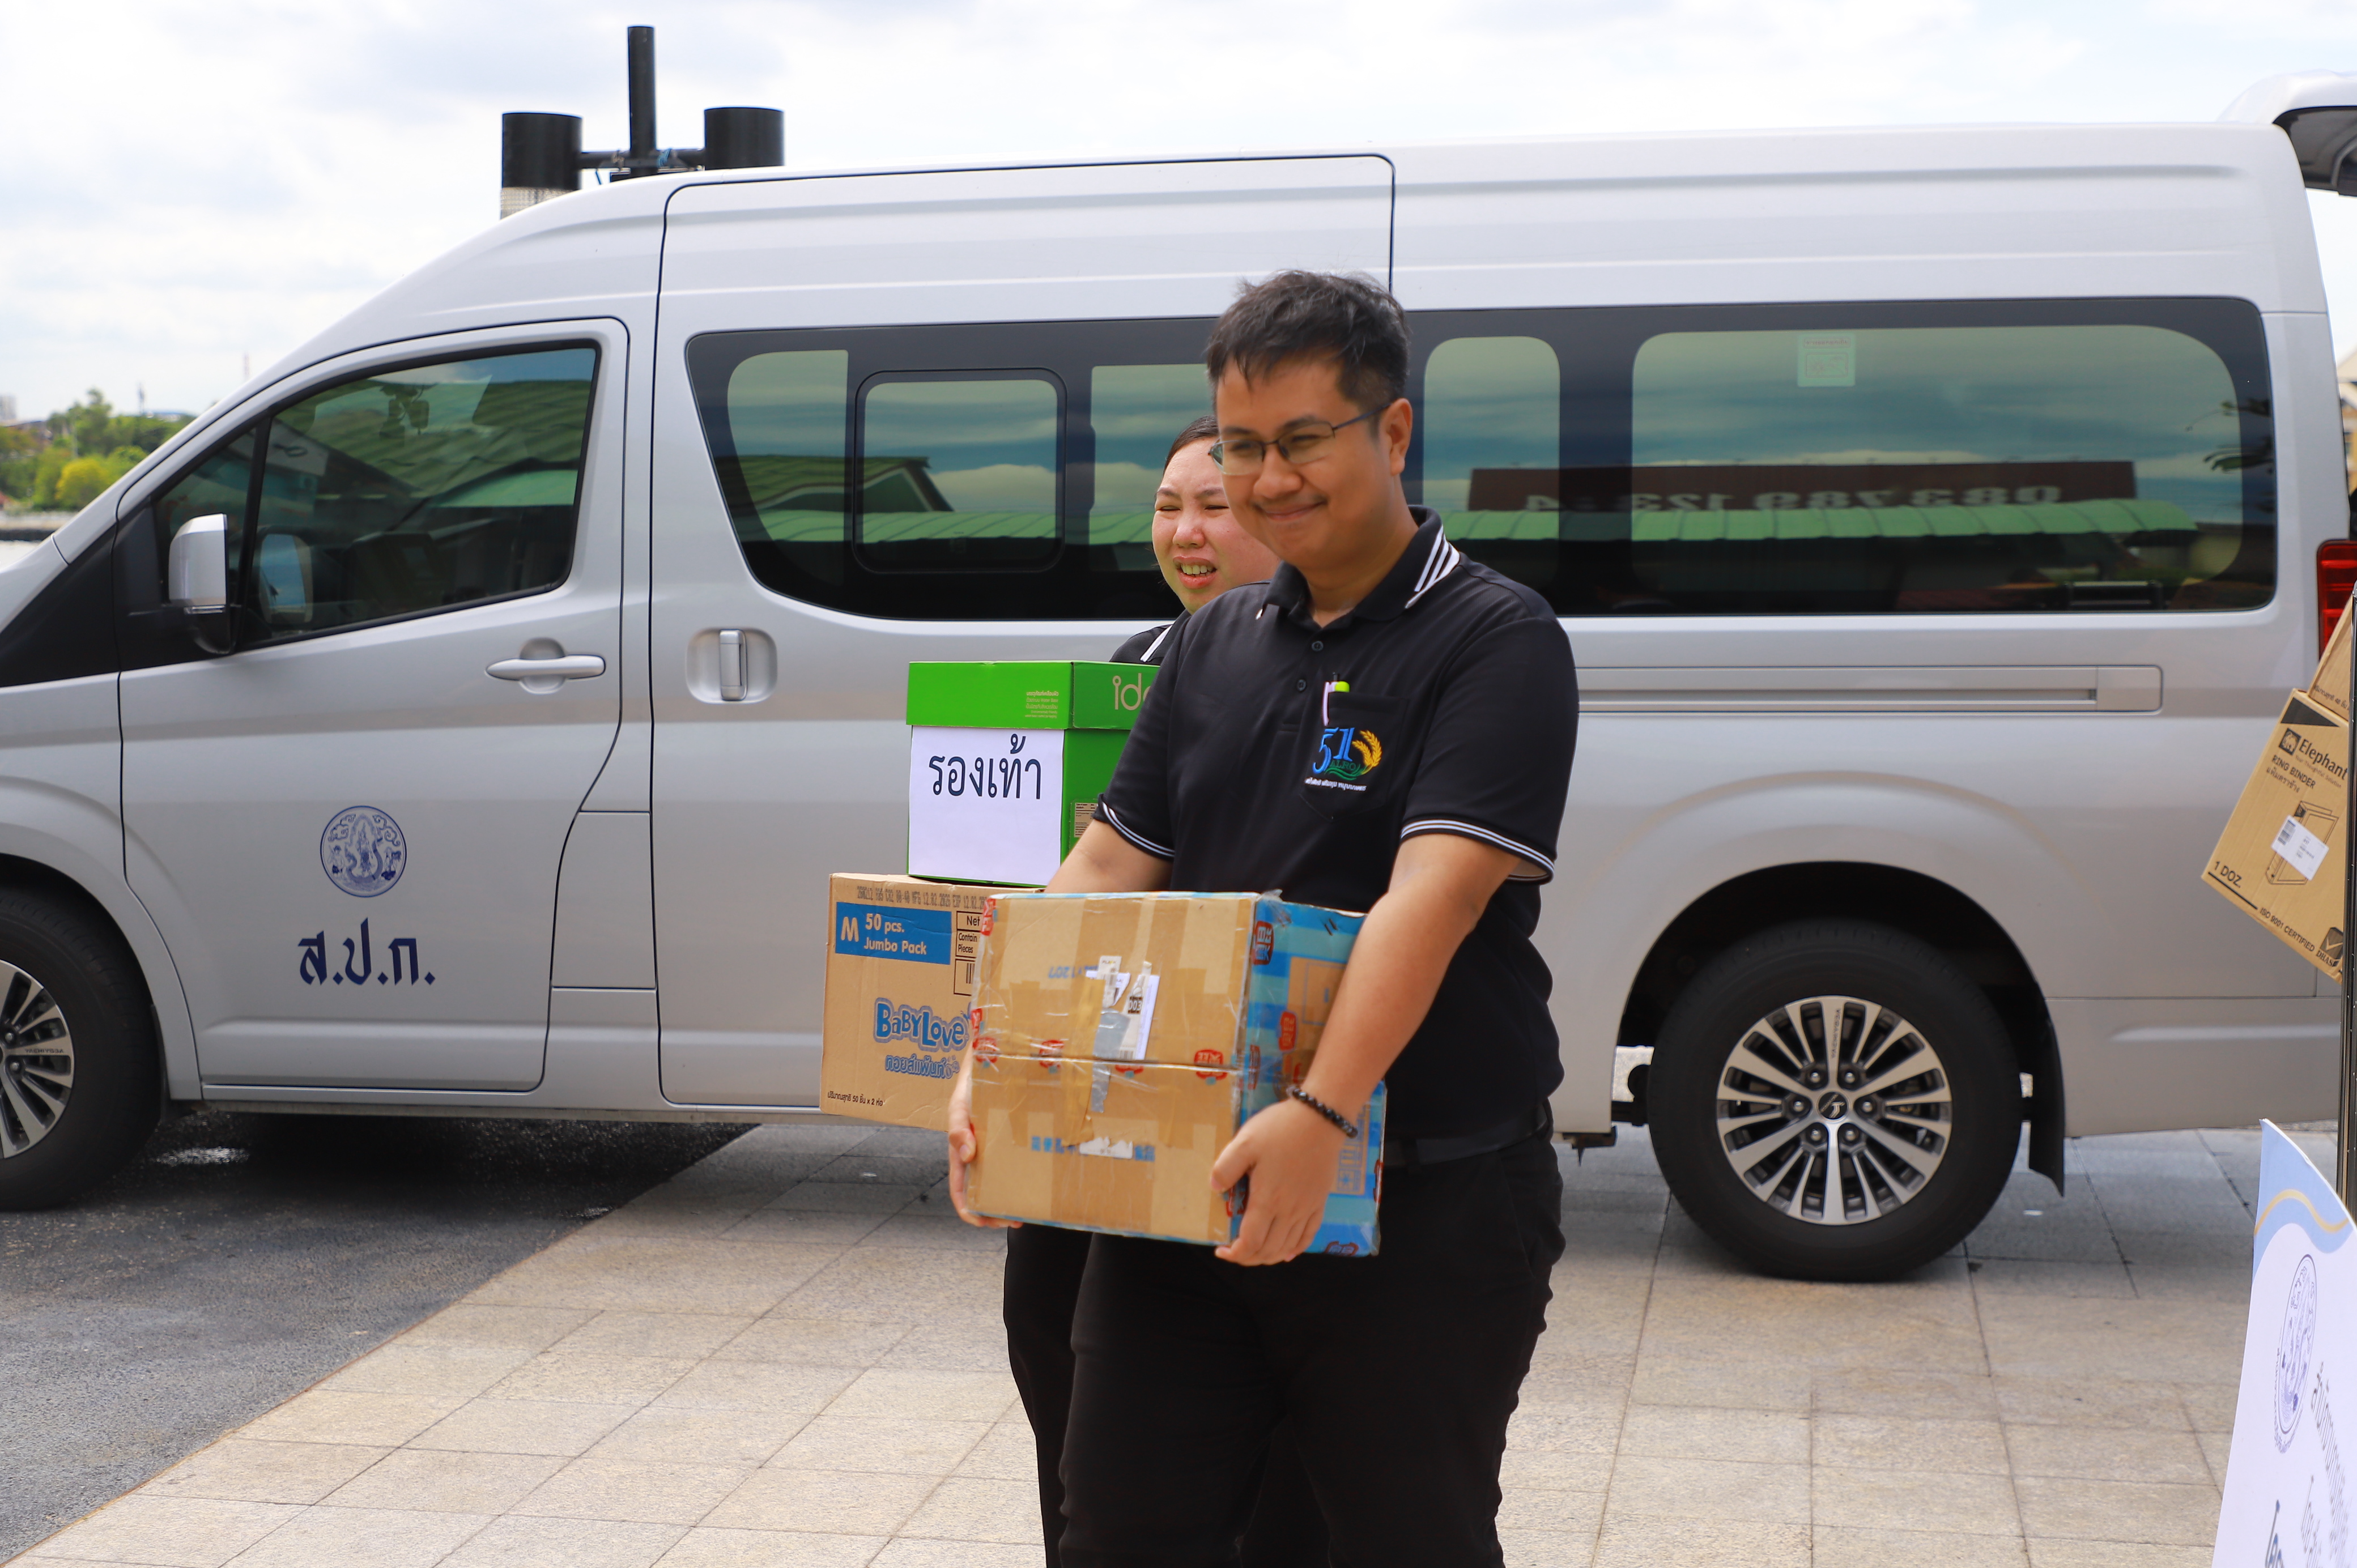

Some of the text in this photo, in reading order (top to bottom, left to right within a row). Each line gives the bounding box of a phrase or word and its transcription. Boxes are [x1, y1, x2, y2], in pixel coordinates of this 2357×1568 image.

[1112, 673, 1155, 711] id
[1312, 727, 1355, 774] 51
[2299, 739, 2348, 781] Elephant
[929, 734, 1042, 800] รองเท้า
[2272, 755, 2316, 789] RING BINDER
[2214, 860, 2220, 870] 1
[840, 916, 859, 942] M
[865, 913, 905, 934] 50 pcs.
[967, 915, 980, 926] Net
[2260, 907, 2315, 952] ISO 9001 CERTIFIED
[297, 917, 436, 986] ส.ป.ก.
[863, 937, 927, 955] Jumbo Pack
[958, 932, 977, 942] Contain
[958, 944, 973, 954] Pieces
